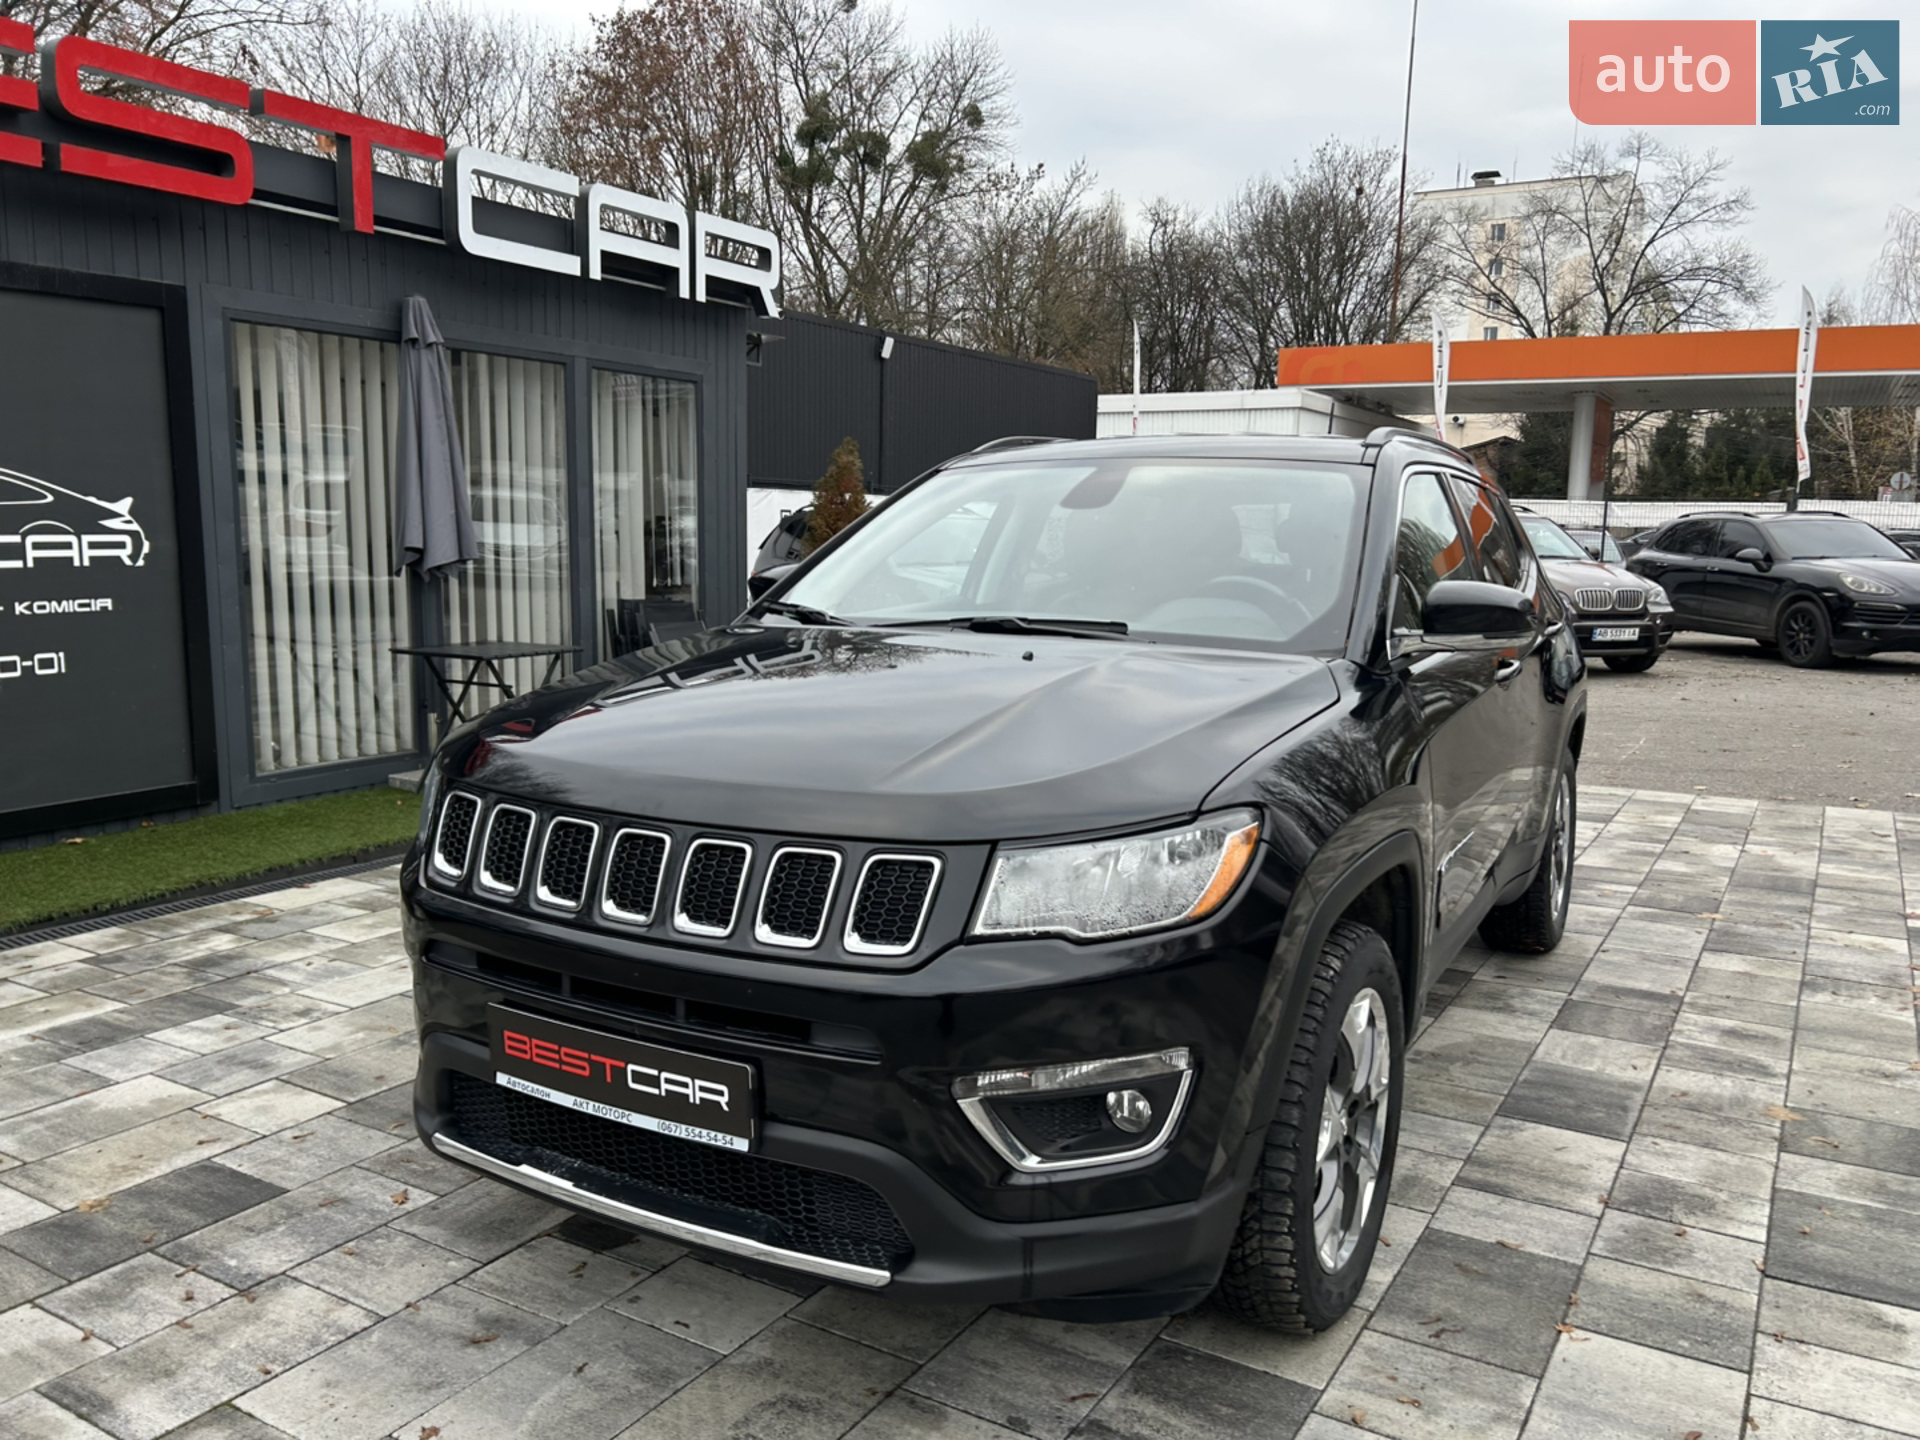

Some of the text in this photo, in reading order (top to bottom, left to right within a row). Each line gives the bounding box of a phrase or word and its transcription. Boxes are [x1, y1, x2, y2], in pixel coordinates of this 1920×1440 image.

[505, 1076, 735, 1146] Автосалон АКТ МОТОРС (067) 554-54-54
